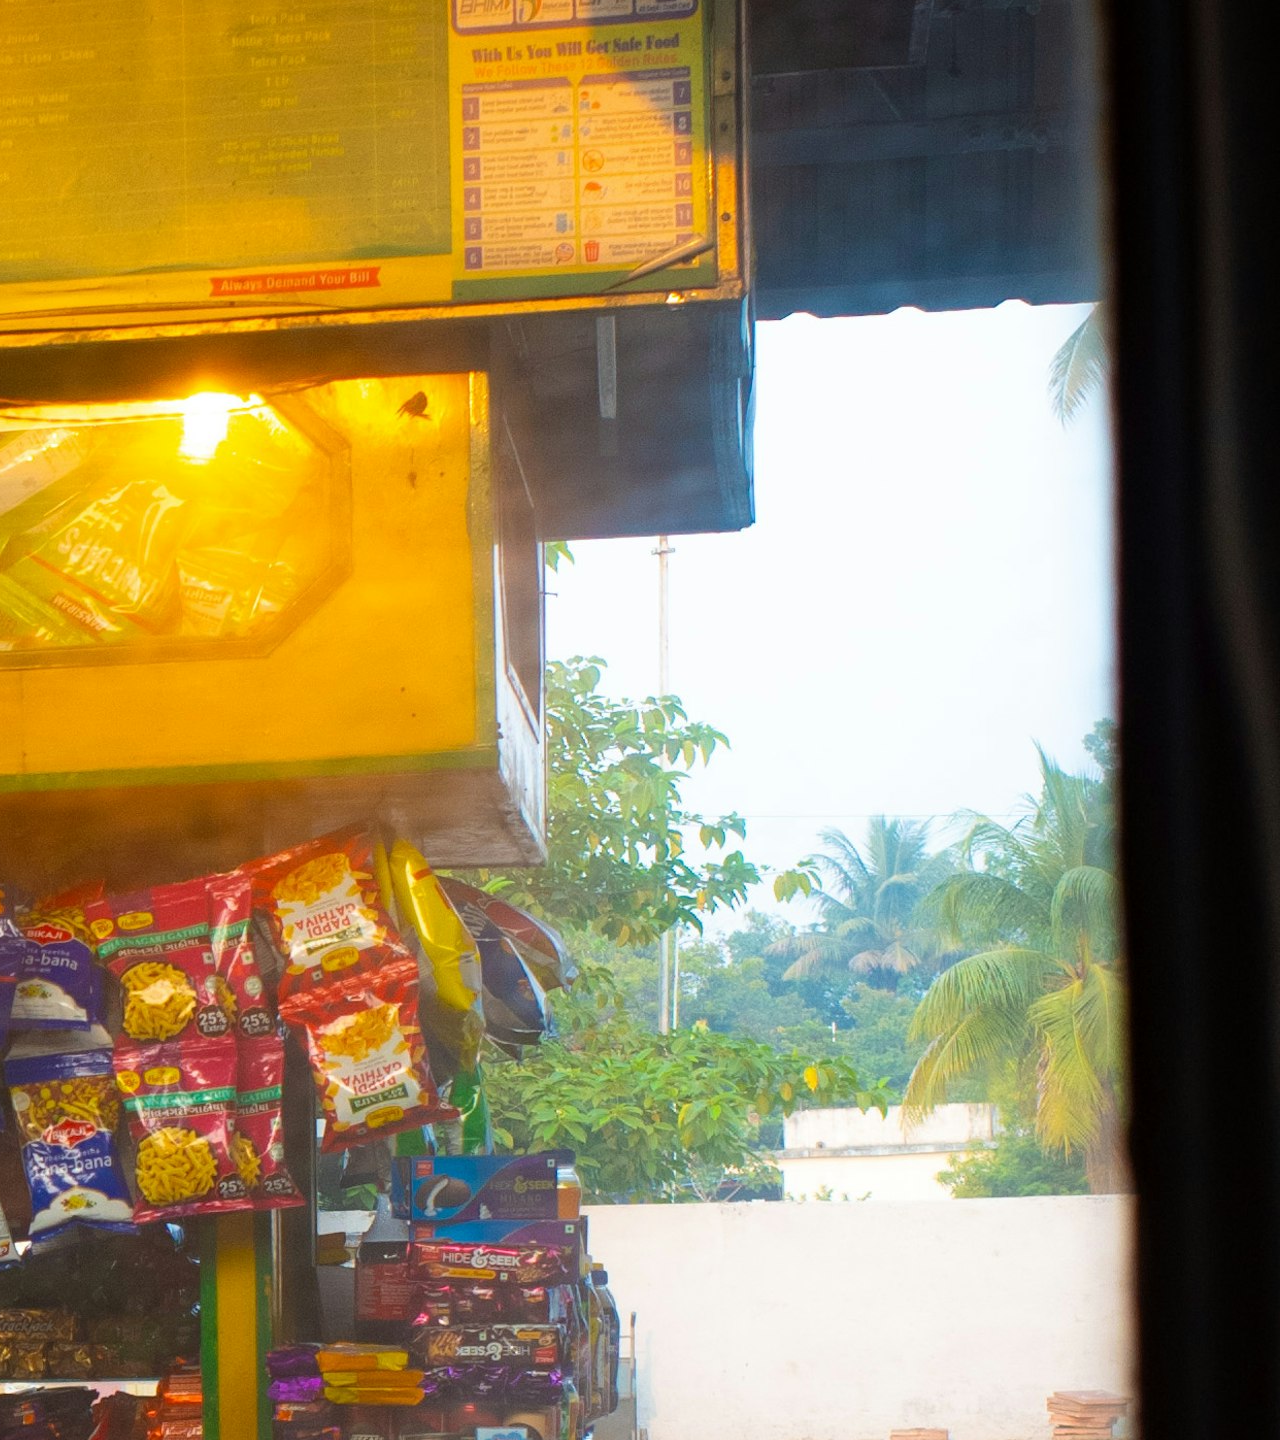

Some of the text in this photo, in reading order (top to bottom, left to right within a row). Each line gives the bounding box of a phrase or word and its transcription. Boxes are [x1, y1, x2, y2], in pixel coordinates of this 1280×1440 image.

[472, 32, 680, 64] With Us You Will Get Safe Food
[496, 61, 537, 76] Follow
[540, 59, 576, 73] These
[640, 52, 678, 66] Rules
[220, 270, 371, 292] Always Demand Your Bill
[26, 928, 64, 940] BIKAJI
[198, 1011, 227, 1026] 25%
[242, 1013, 270, 1028] 25%
